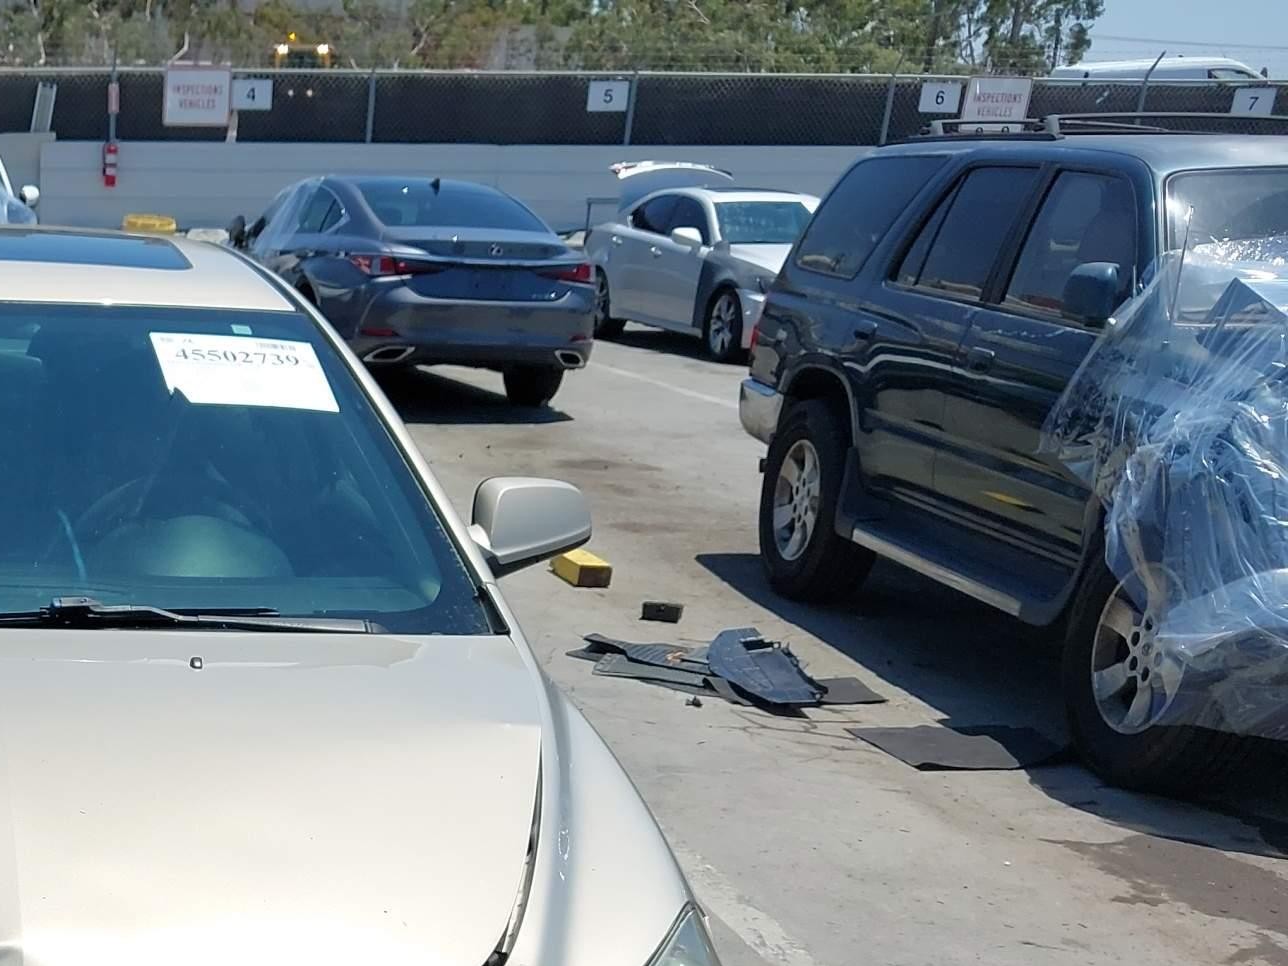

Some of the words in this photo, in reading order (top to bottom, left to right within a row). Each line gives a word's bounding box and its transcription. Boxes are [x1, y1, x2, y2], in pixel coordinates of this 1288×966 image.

[246, 87, 256, 102] 4
[603, 88, 614, 104] 5
[935, 90, 945, 105] 6
[973, 92, 1023, 104] INSPECTIONS
[1248, 96, 1259, 111] 7
[977, 106, 1013, 118] VEHICLES
[175, 348, 300, 366] 45502739
